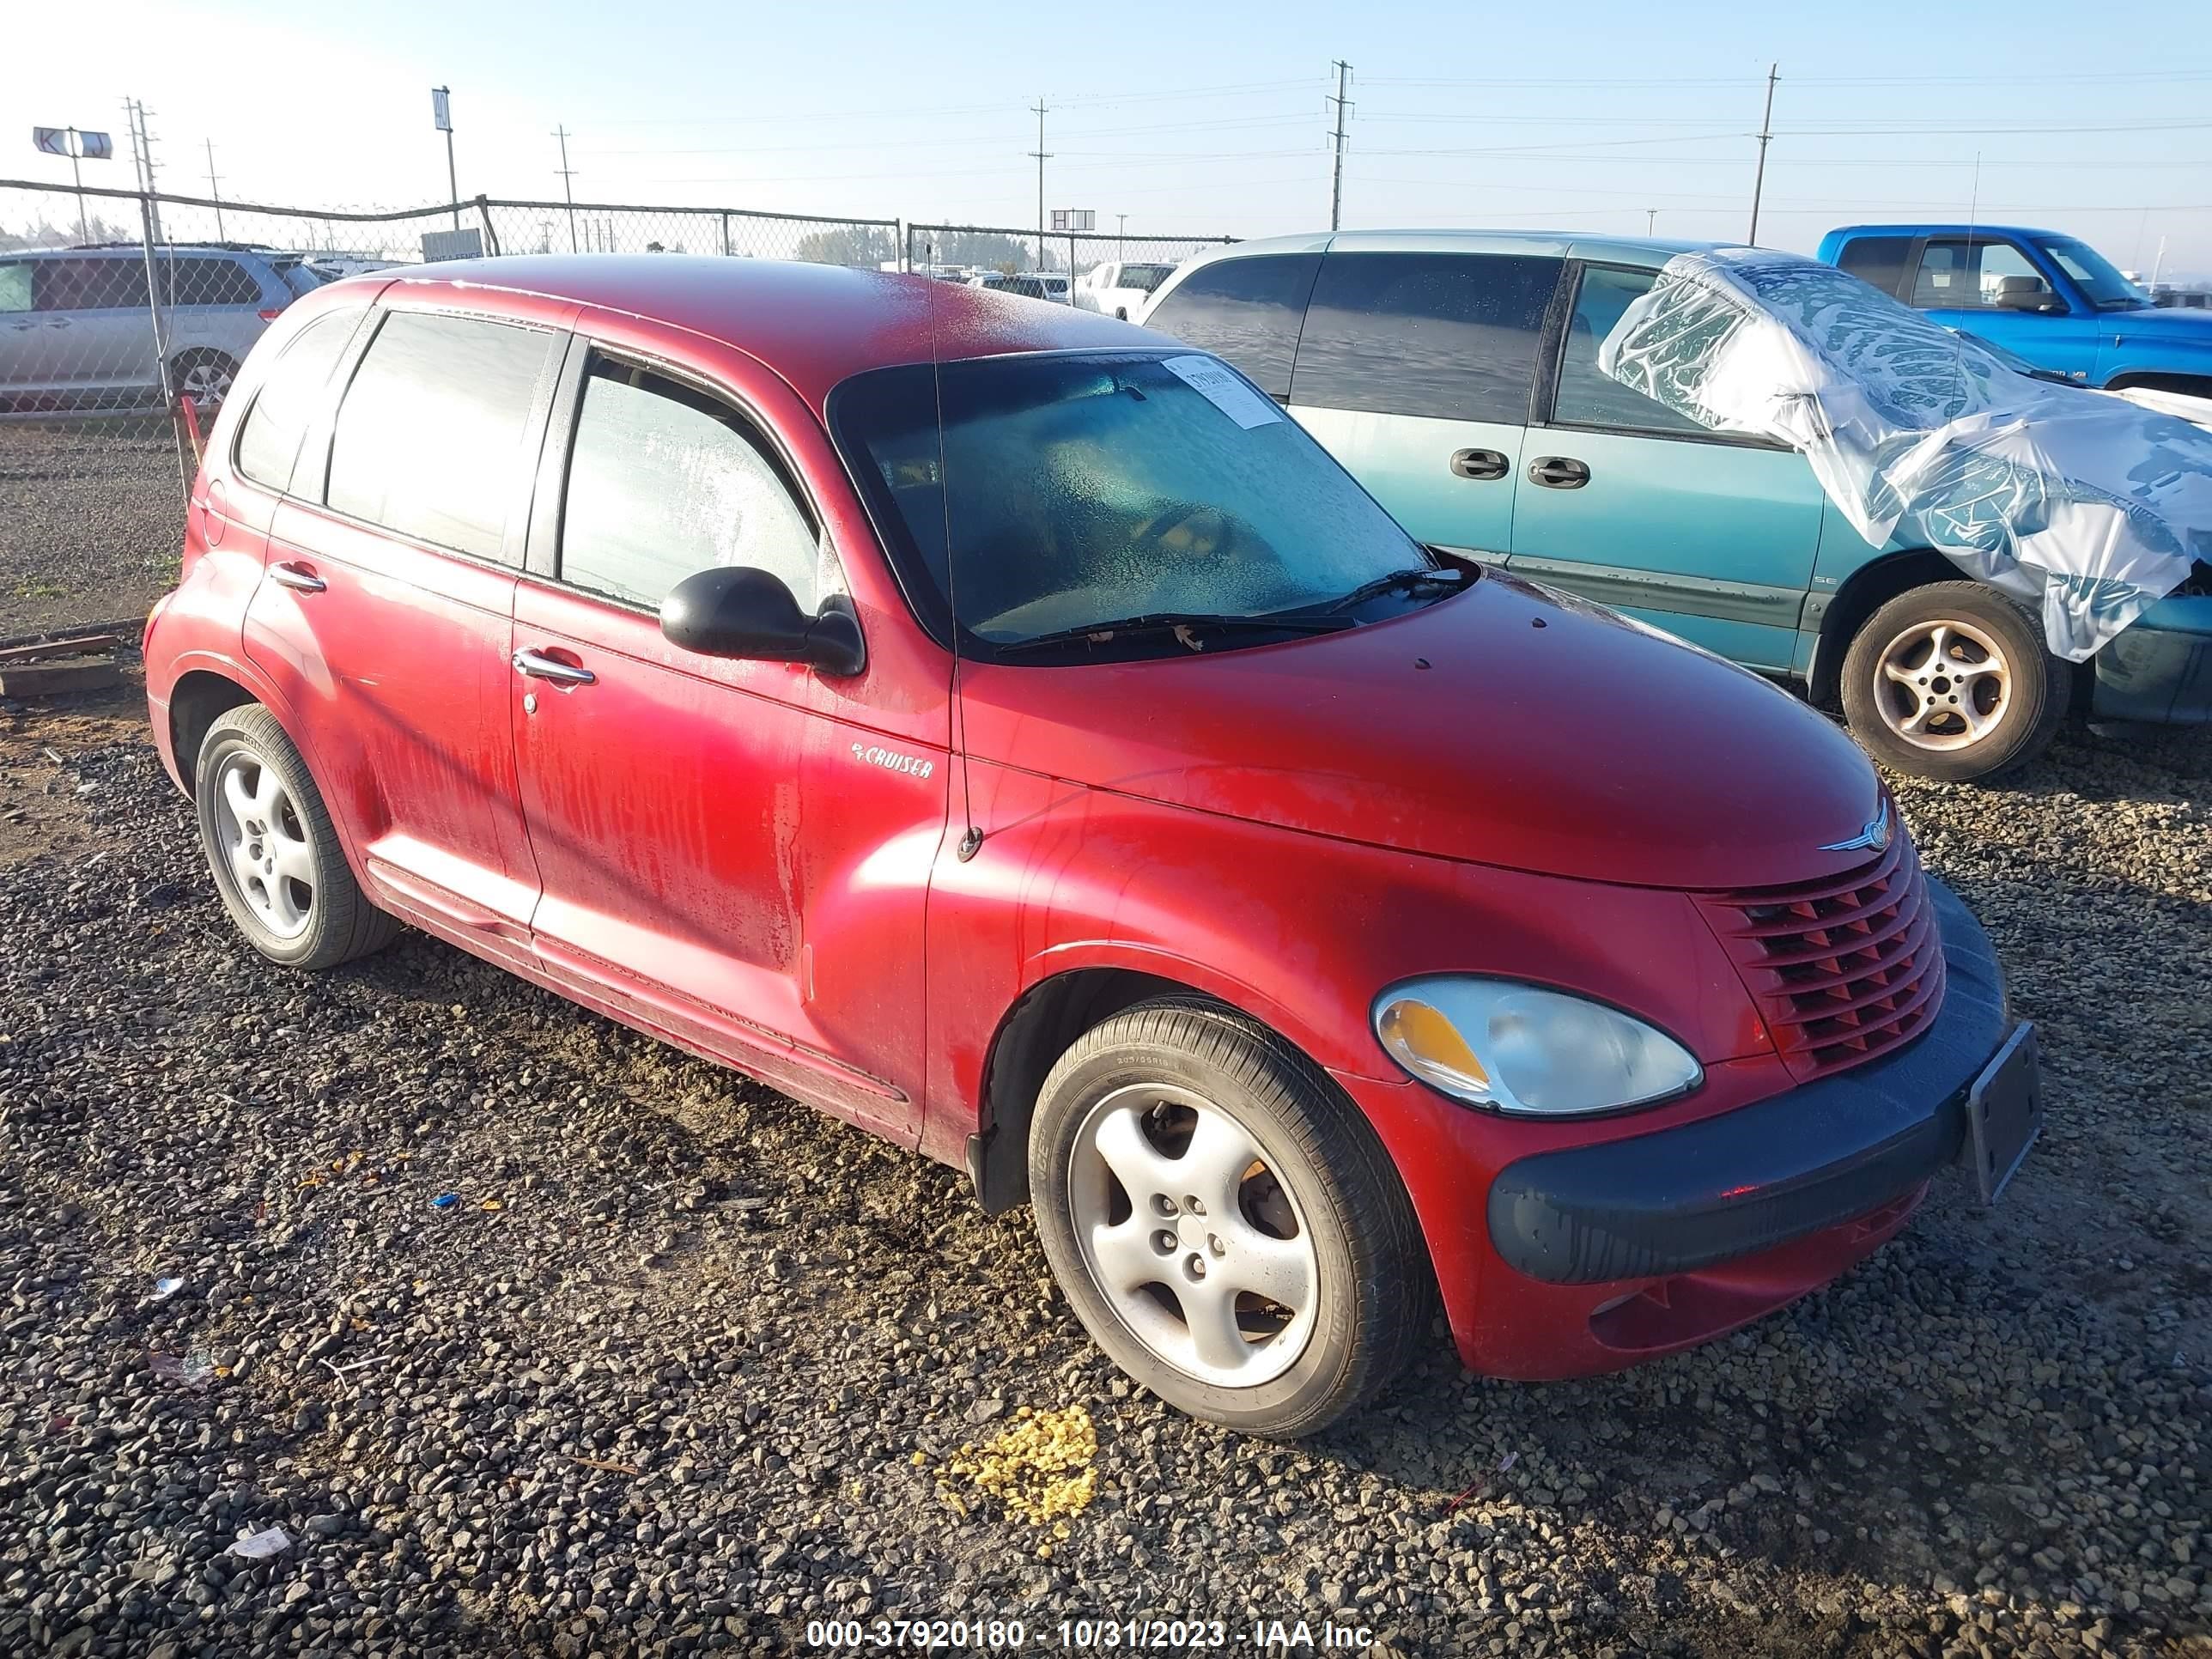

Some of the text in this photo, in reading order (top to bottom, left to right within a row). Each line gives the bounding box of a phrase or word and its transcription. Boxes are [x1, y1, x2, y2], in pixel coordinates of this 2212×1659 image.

[40, 130, 60, 153] K
[91, 134, 104, 156] J
[1814, 576, 1838, 585] SE
[864, 746, 934, 779] CRUISER
